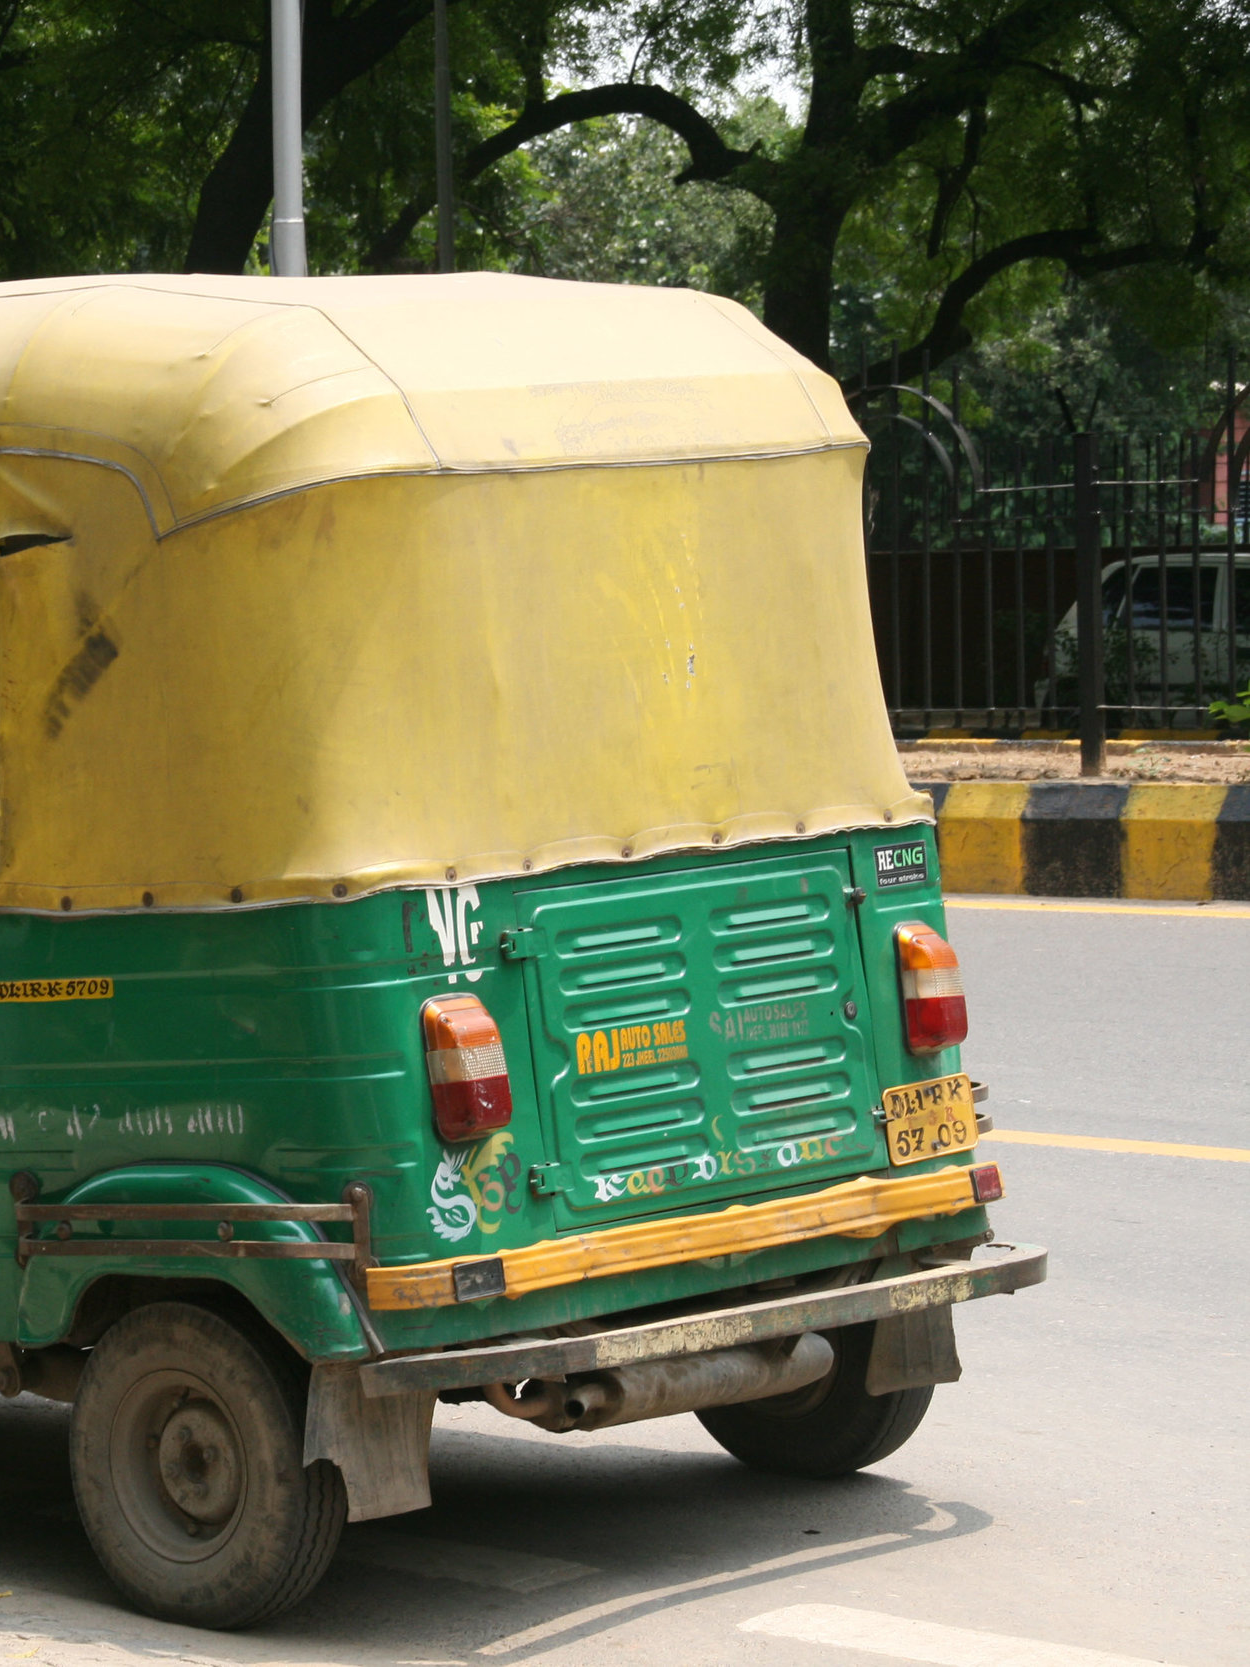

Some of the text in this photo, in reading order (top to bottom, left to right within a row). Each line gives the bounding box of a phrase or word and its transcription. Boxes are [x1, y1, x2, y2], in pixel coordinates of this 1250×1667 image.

[65, 979, 110, 996] 5709
[744, 1006, 772, 1023] AUTO
[576, 1020, 686, 1075] RAJ AUTO SALES
[622, 1052, 635, 1068] 223
